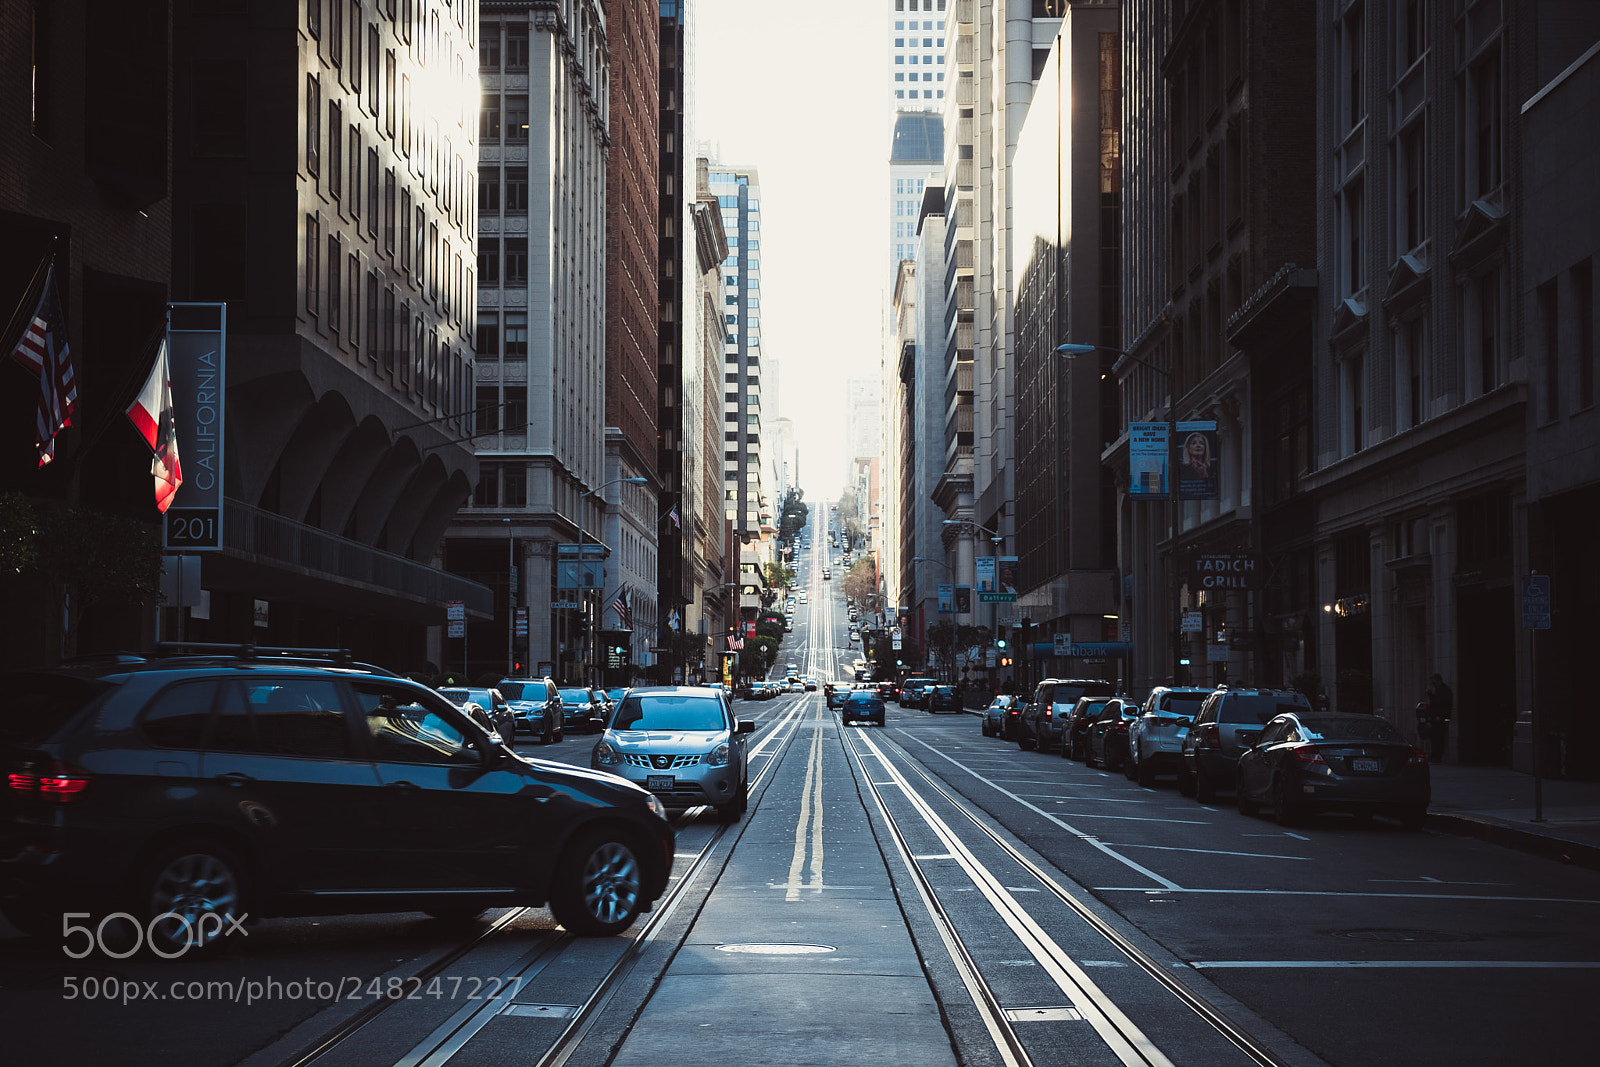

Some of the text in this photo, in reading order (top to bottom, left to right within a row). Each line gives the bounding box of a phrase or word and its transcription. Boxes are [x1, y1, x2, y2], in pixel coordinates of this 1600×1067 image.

[195, 350, 217, 490] CALIFORNIA
[172, 517, 214, 540] 201
[1196, 559, 1254, 572] TADICH
[1203, 575, 1247, 588] GRILL
[983, 594, 1013, 602] Battery
